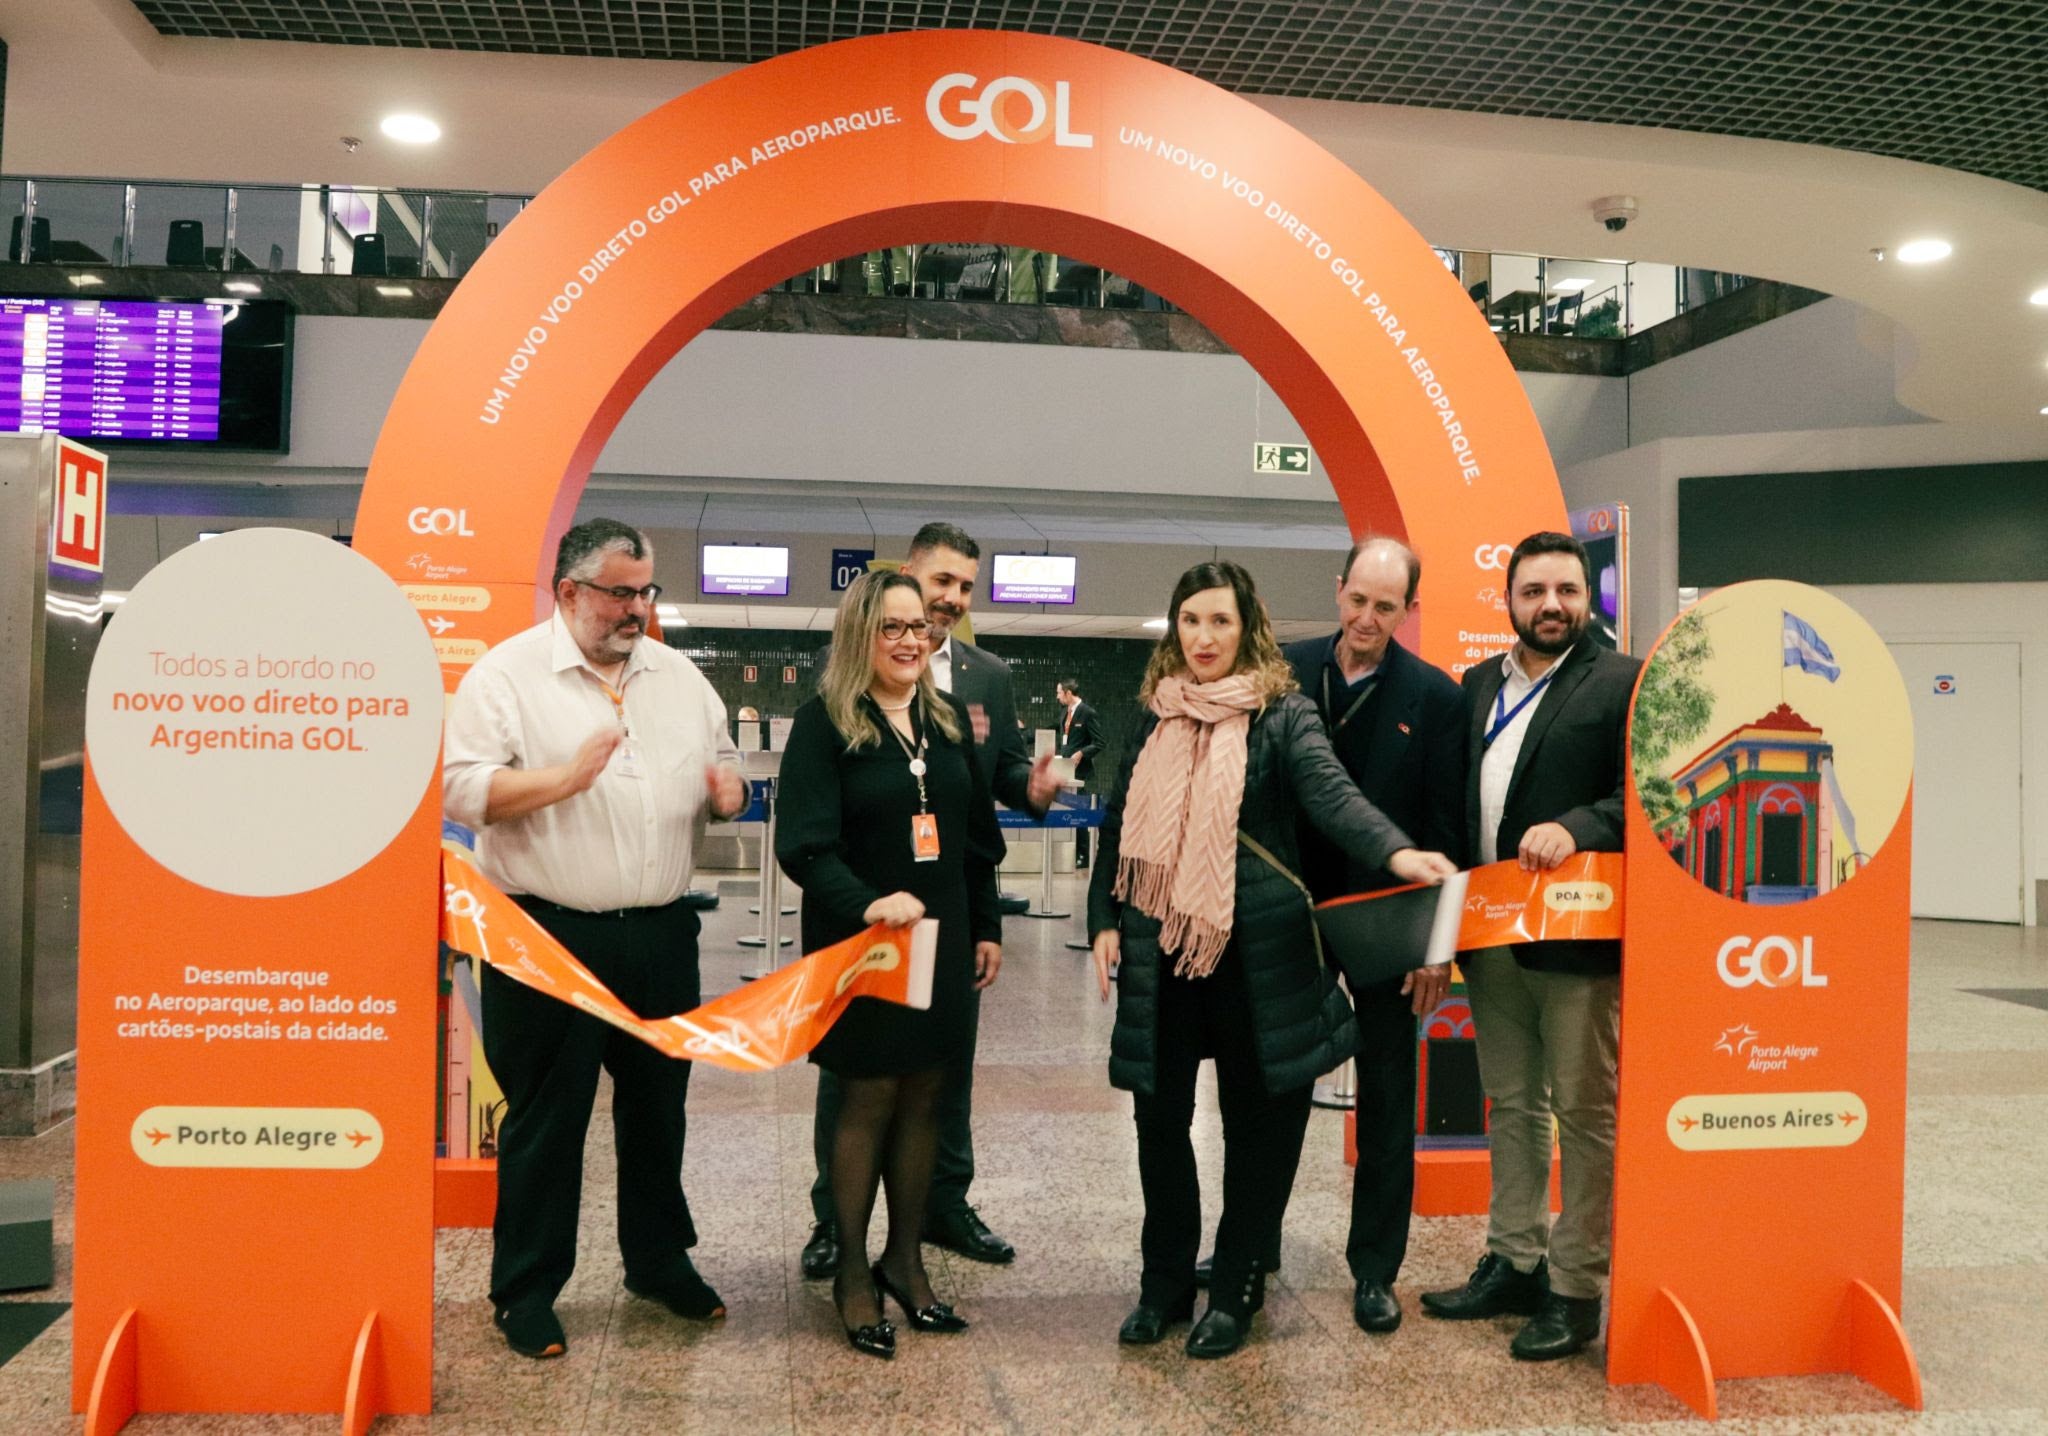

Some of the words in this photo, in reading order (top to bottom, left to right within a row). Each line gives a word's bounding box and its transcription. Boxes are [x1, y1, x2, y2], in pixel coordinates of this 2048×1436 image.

[926, 73, 1093, 148] GOL
[479, 388, 510, 425] UM
[499, 326, 548, 389] NOVO
[540, 281, 584, 325] VOO
[578, 219, 648, 285] DIRETO
[646, 190, 691, 225] GOL
[688, 156, 748, 197] PARA
[750, 105, 901, 166] AEROPARQUE.
[1119, 126, 1152, 153] UM
[1156, 139, 1217, 180] NOVO
[1221, 171, 1265, 208] VOO
[1264, 200, 1332, 260] DIRETO
[1330, 257, 1366, 298] GOL
[1362, 293, 1407, 347] PARA
[1401, 346, 1481, 486] AEROPARQUE.
[62, 462, 98, 551] H
[408, 506, 475, 537] GOL
[1588, 509, 1616, 533] GOL
[1474, 544, 1515, 570] GO
[407, 592, 438, 602] Porto
[441, 593, 477, 605] Alegre
[1459, 630, 1520, 643] Desembar
[1465, 646, 1481, 658] do
[149, 652, 226, 678] Todos
[235, 658, 249, 678] a
[257, 654, 334, 680] bordo
[342, 660, 375, 680] no
[113, 692, 184, 712] novo
[193, 694, 245, 713] voo
[254, 689, 338, 715] direto
[347, 697, 409, 721] para
[150, 724, 293, 754] Argentina
[303, 727, 368, 752] GOL.
[1555, 891, 1581, 901] POA
[1716, 935, 1828, 988] GOL
[185, 966, 329, 990] Desembarque
[115, 995, 142, 1010] no
[147, 992, 274, 1015] Aeroparque,
[279, 997, 304, 1012] ao
[310, 995, 353, 1013] lado
[358, 996, 397, 1014] dos
[118, 1019, 281, 1042] cartões-postais
[287, 1022, 312, 1040] da
[317, 1022, 388, 1041] cidade.
[1750, 1045, 1781, 1058] Porto
[1783, 1045, 1819, 1060] Alegre
[1747, 1058, 1787, 1073] Airport
[1701, 1112, 1776, 1130] Buenos
[1782, 1109, 1833, 1128] Aires
[177, 1126, 247, 1146] Porto
[255, 1127, 337, 1151] Alegre
